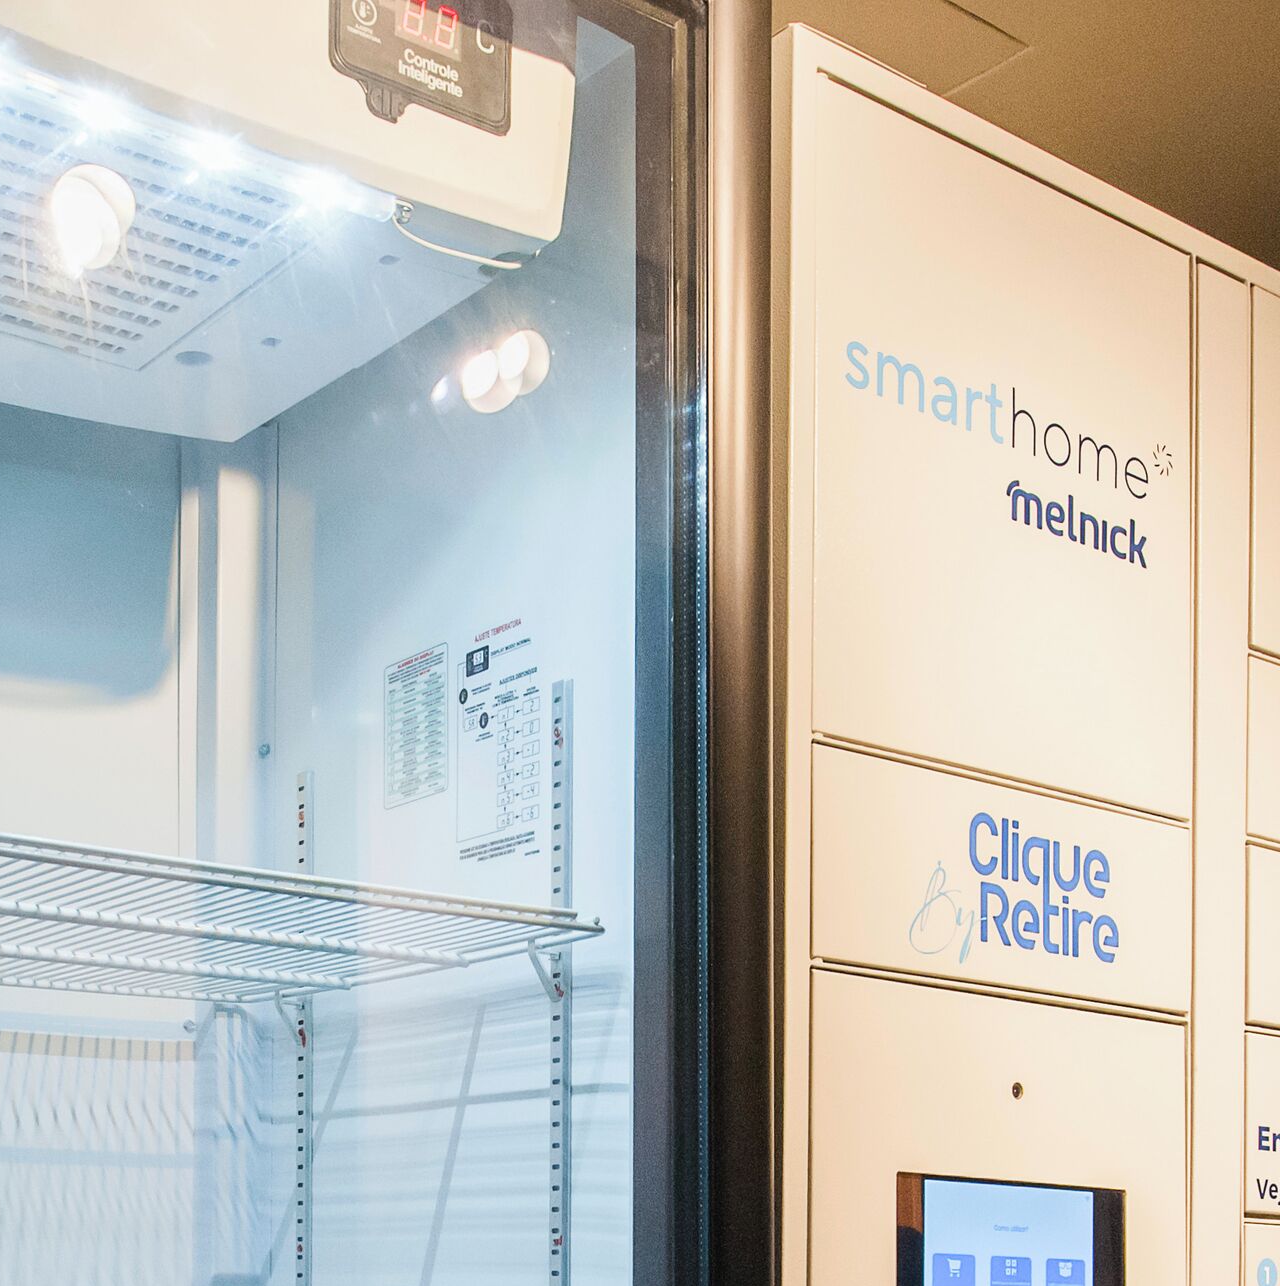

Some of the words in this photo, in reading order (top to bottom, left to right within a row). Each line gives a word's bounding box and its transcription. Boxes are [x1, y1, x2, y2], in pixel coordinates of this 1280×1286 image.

[398, 59, 463, 98] Inteligente
[404, 48, 459, 82] Controle
[844, 340, 1149, 499] smarthome
[1006, 480, 1147, 568] melnick
[969, 812, 1110, 899] Clique
[980, 881, 1119, 963] Retire
[1264, 1266, 1270, 1285] 1
